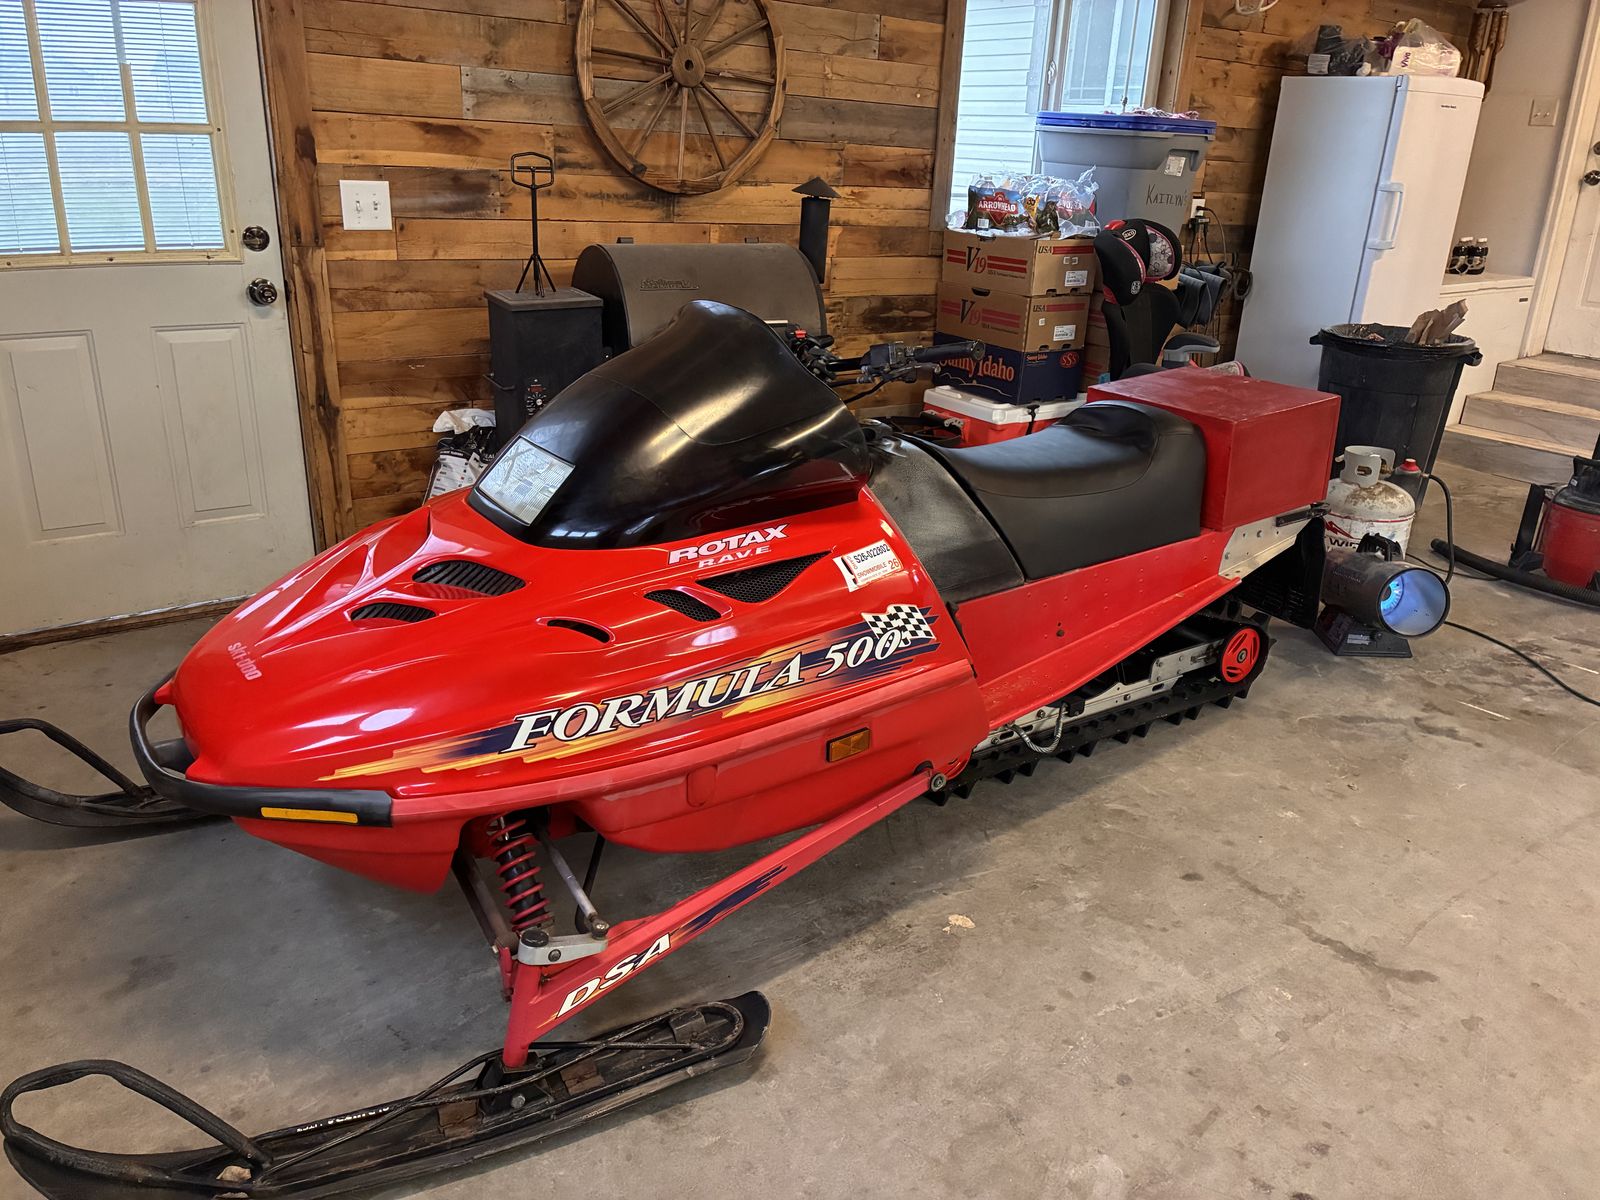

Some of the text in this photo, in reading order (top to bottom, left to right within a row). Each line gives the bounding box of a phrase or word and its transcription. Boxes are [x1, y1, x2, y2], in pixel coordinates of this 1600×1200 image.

[978, 200, 1016, 212] ARROWHEAD
[966, 246, 987, 274] V19
[1038, 246, 1052, 254] USA
[960, 299, 982, 326] V19
[1033, 304, 1046, 312] USA
[977, 355, 1015, 381] Idaho
[668, 524, 788, 565] ROTAX
[698, 545, 771, 568] R.A.V.E.
[857, 562, 887, 579] SNOWMOBILE
[888, 558, 900, 570] 26
[499, 628, 901, 754] FORMULA 500
[557, 933, 671, 1018] DSA
